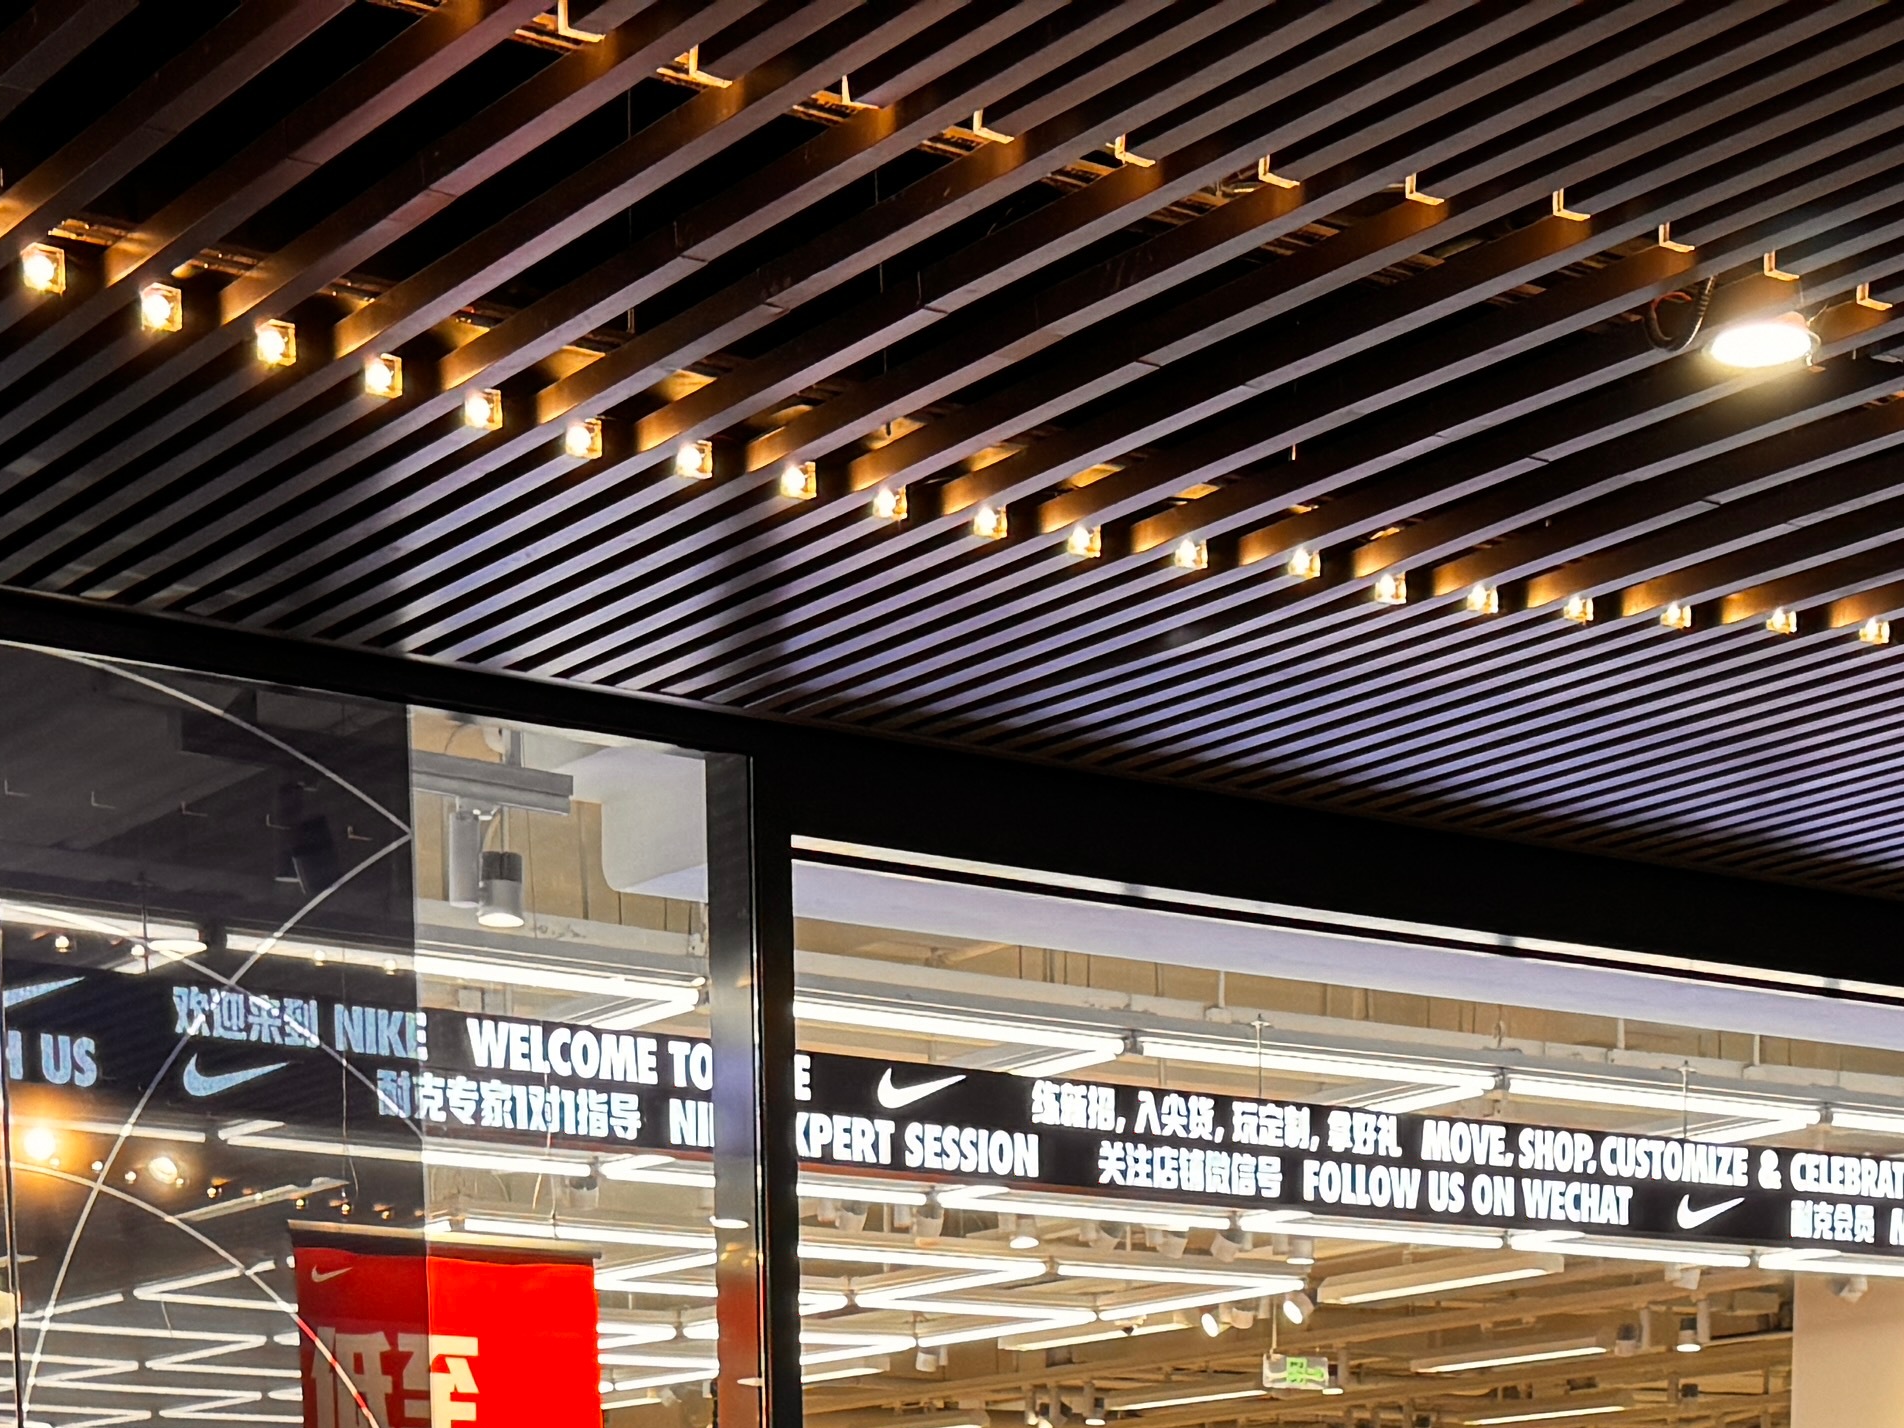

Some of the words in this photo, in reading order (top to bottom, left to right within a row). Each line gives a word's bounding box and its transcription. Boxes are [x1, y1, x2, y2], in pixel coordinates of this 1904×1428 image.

[43, 1032, 97, 1088] US
[172, 985, 318, 1048] 欢迎来到
[333, 1005, 429, 1060] NIKE
[466, 1019, 657, 1081] WELCOME
[904, 1121, 1039, 1177] SESSION
[1600, 1136, 1749, 1187] CUSTOMIZE
[1758, 1149, 1781, 1190] &
[1098, 1140, 1282, 1198] 关注店铺微信号
[1303, 1160, 1420, 1210] FOLLOW
[1427, 1171, 1464, 1213] US
[1471, 1175, 1514, 1218] ON
[1522, 1179, 1633, 1227] WECHAT
[1791, 1200, 1875, 1244] 耐克会员
